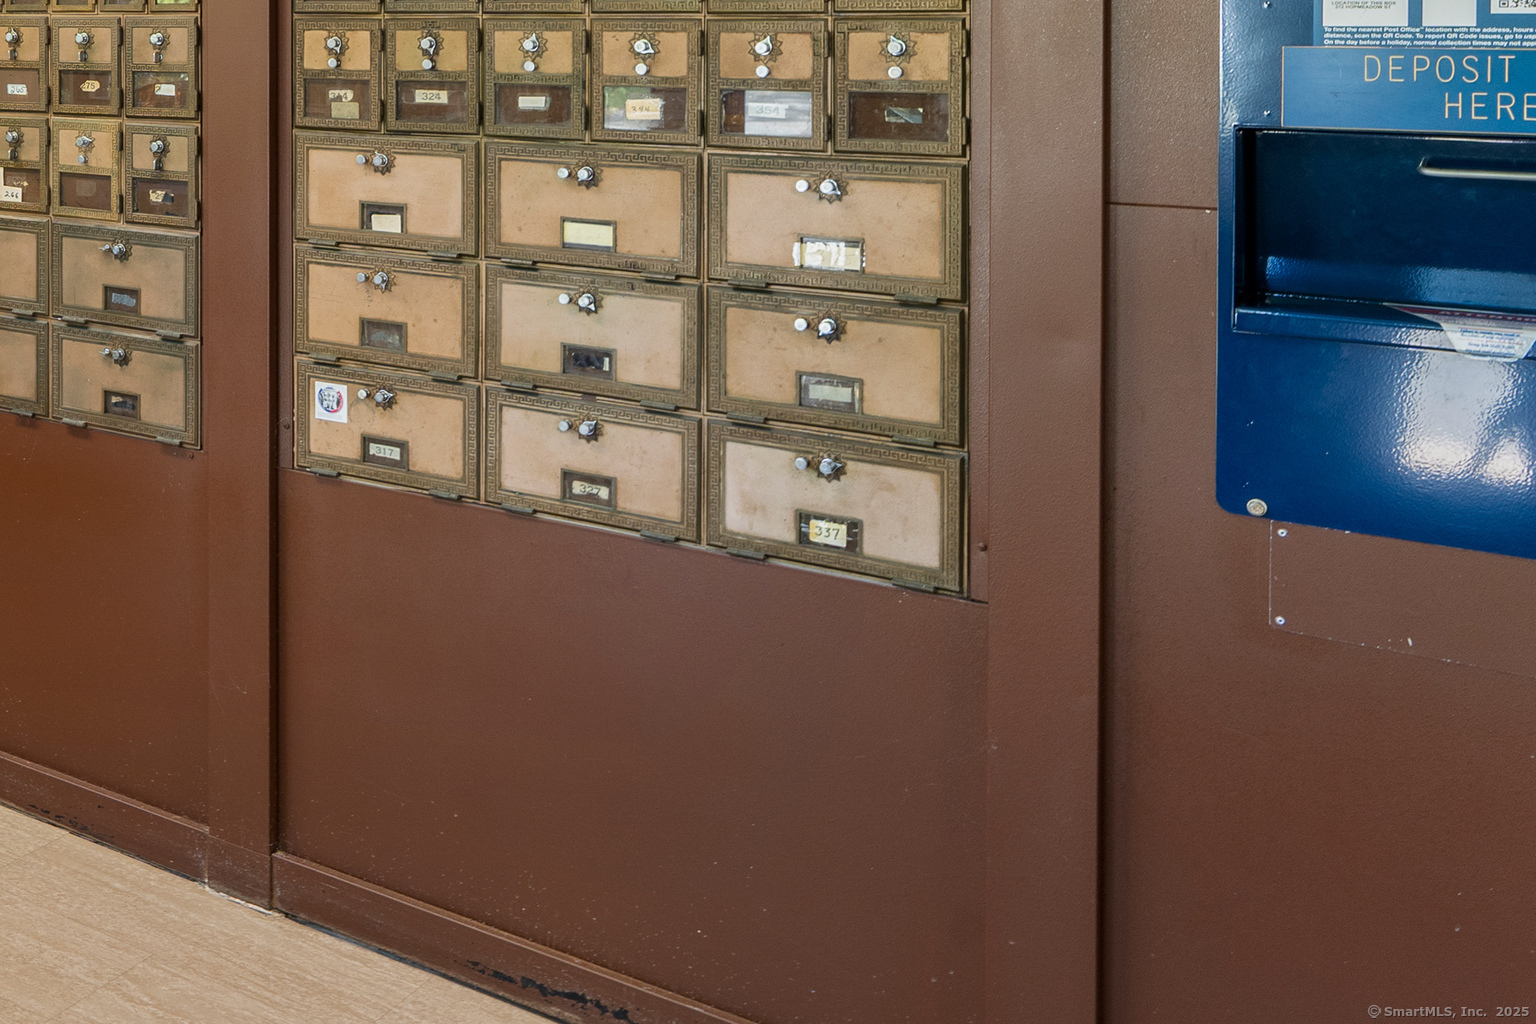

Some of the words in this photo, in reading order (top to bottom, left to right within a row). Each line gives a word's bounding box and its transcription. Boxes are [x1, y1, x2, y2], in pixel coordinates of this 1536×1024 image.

[1364, 55, 1516, 84] DEPOSIT
[421, 92, 441, 101] 324
[756, 105, 780, 114] 354
[1444, 92, 1536, 121] HERE
[375, 447, 394, 457] 317
[579, 484, 601, 495] 327
[814, 526, 840, 541] 337
